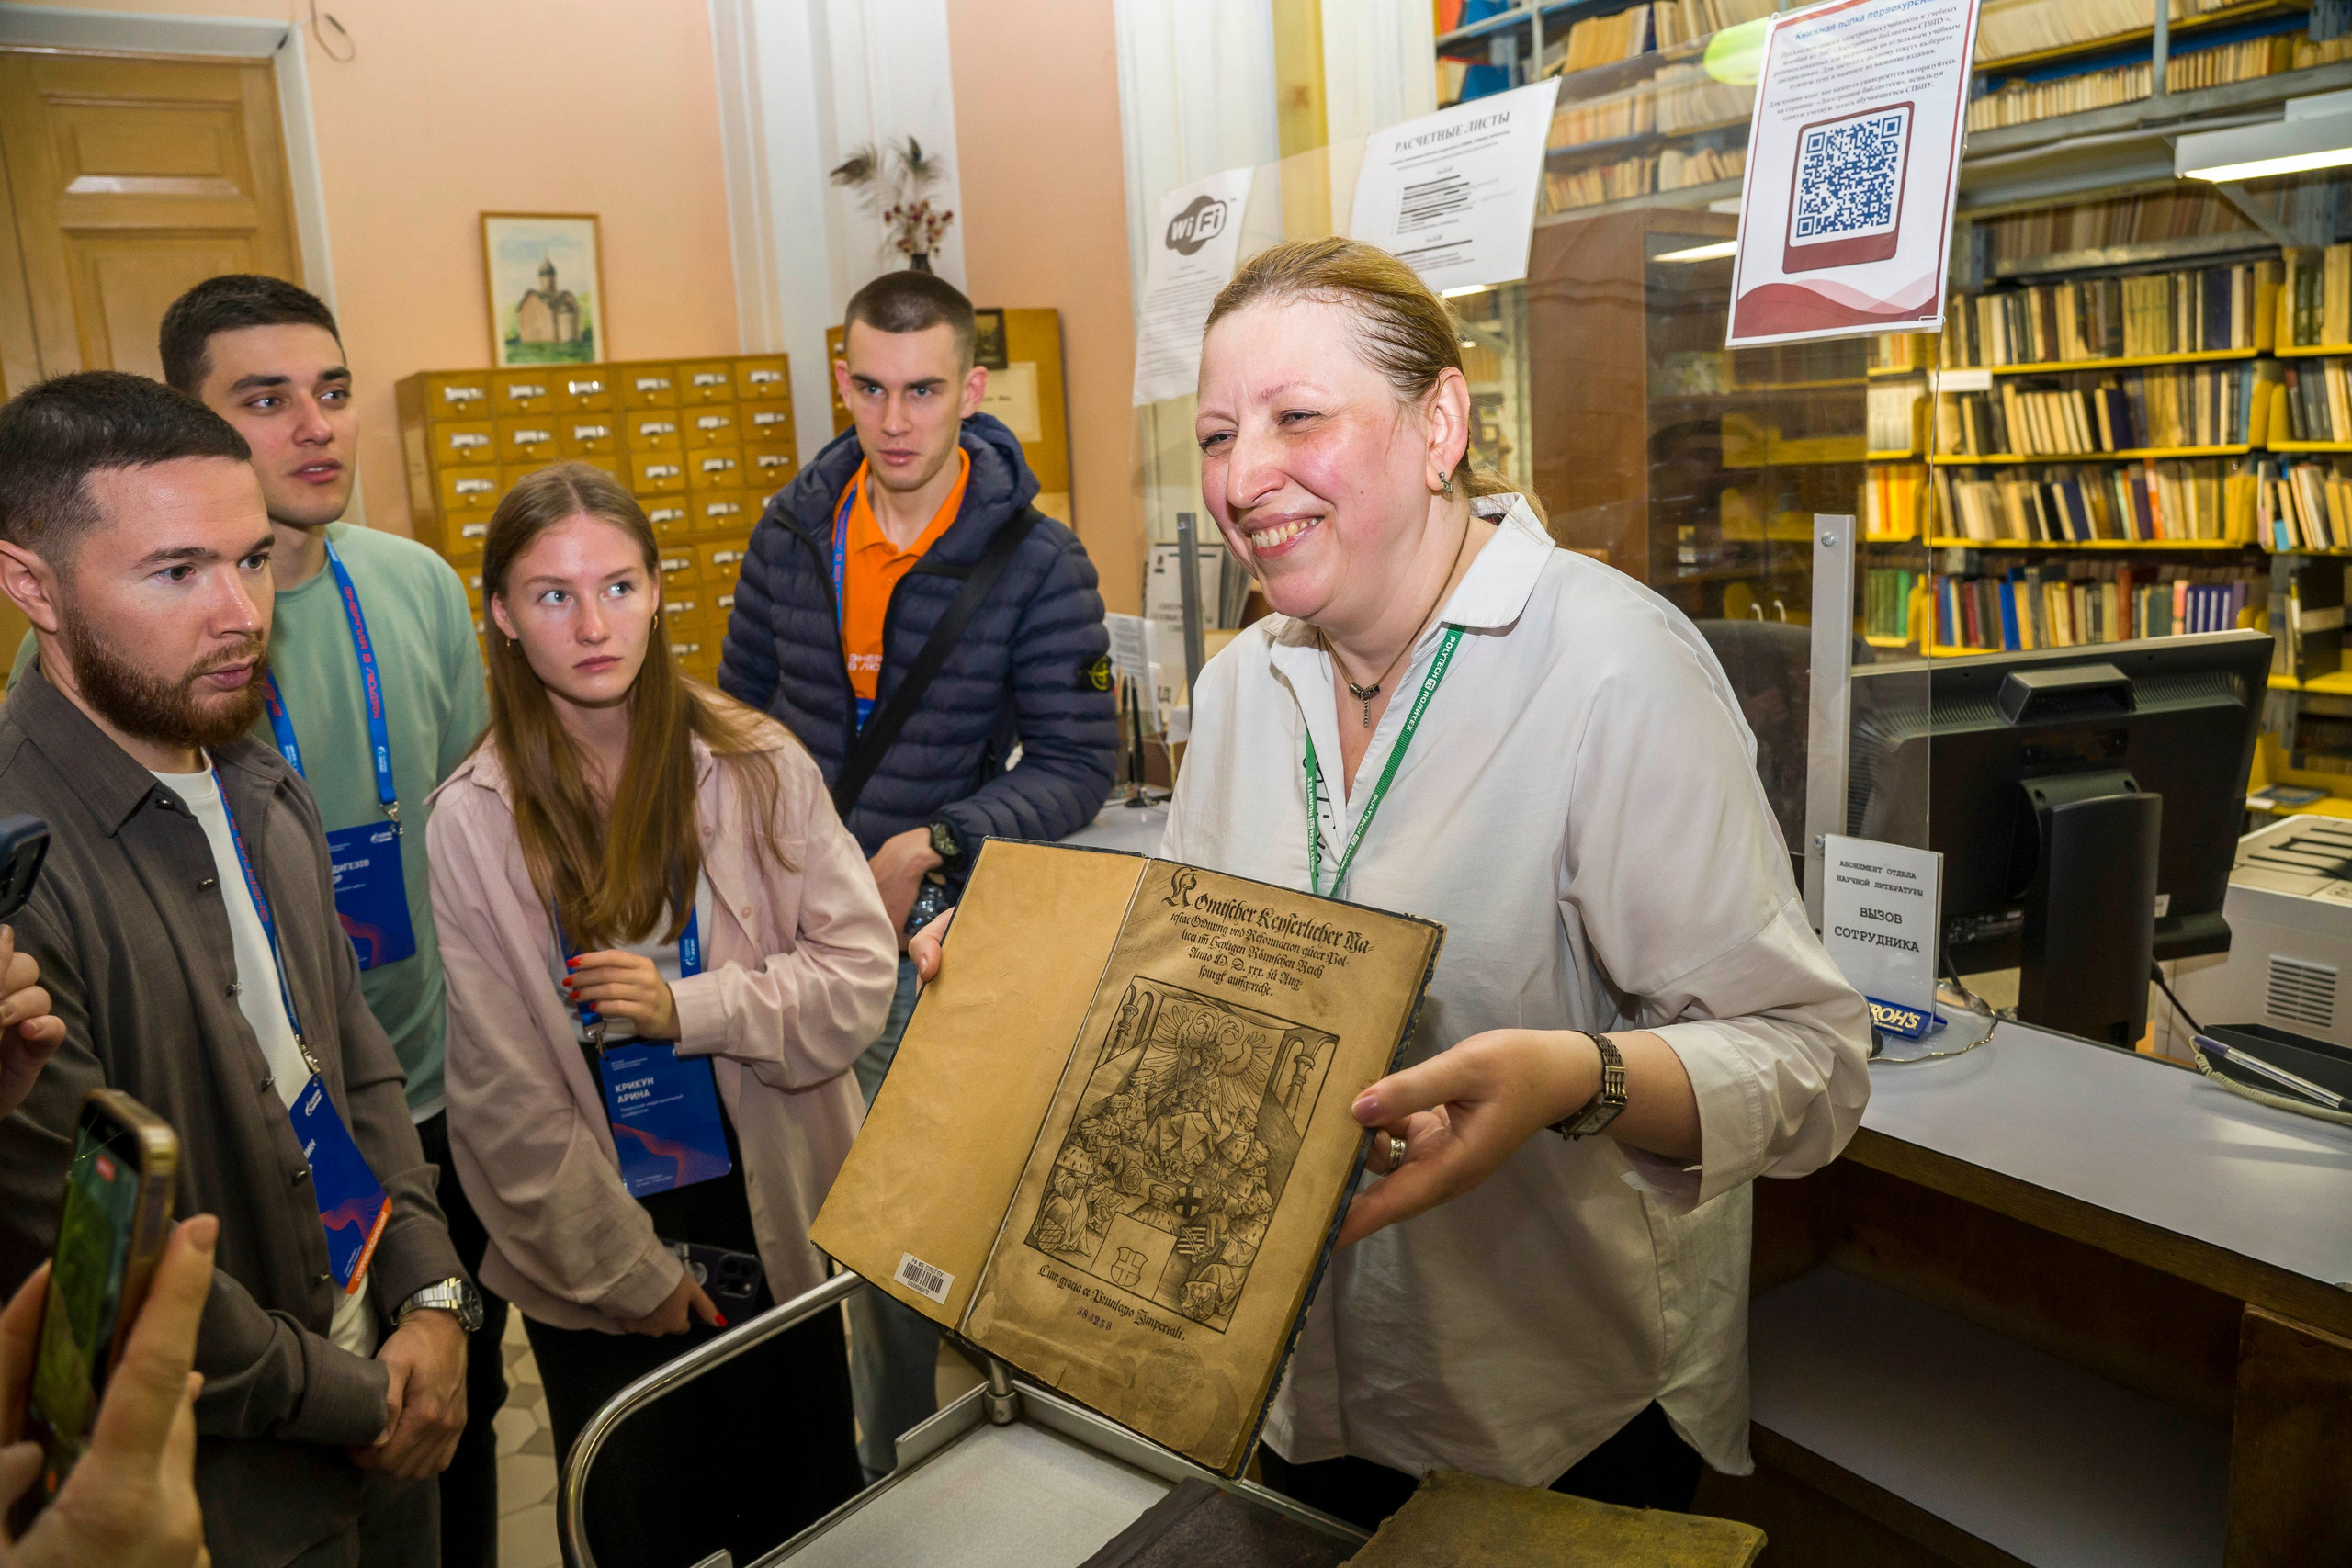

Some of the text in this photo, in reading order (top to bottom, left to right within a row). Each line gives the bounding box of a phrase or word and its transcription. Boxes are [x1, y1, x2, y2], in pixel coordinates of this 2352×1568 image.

[1838, 15, 1865, 29] полка
[1867, 0, 1935, 19] первокурсн
[1394, 124, 1464, 153] РАСЧЕТНЫЕ
[1464, 112, 1510, 134] ЛИСТЫ
[1431, 636, 1456, 679] POLYTECH
[1407, 689, 1430, 731] ПОЛИТЕХ
[1357, 794, 1378, 834] POLYTECH
[1839, 861, 1917, 880] АБОНЕМЕНТ ОТДЕЛА
[1837, 875, 1923, 897] НАУЧНОЙ ЛИТЕРАТУРЫ
[1860, 907, 1902, 924] ВЫЗОВ
[1834, 926, 1919, 953] СОТРУДНИКА
[1188, 946, 1212, 961] Anno
[1869, 1003, 1921, 1029] ROH'S
[615, 1077, 654, 1093] КРИКУН
[616, 1089, 651, 1104] АРИНА
[1037, 1264, 1058, 1282] Cum
